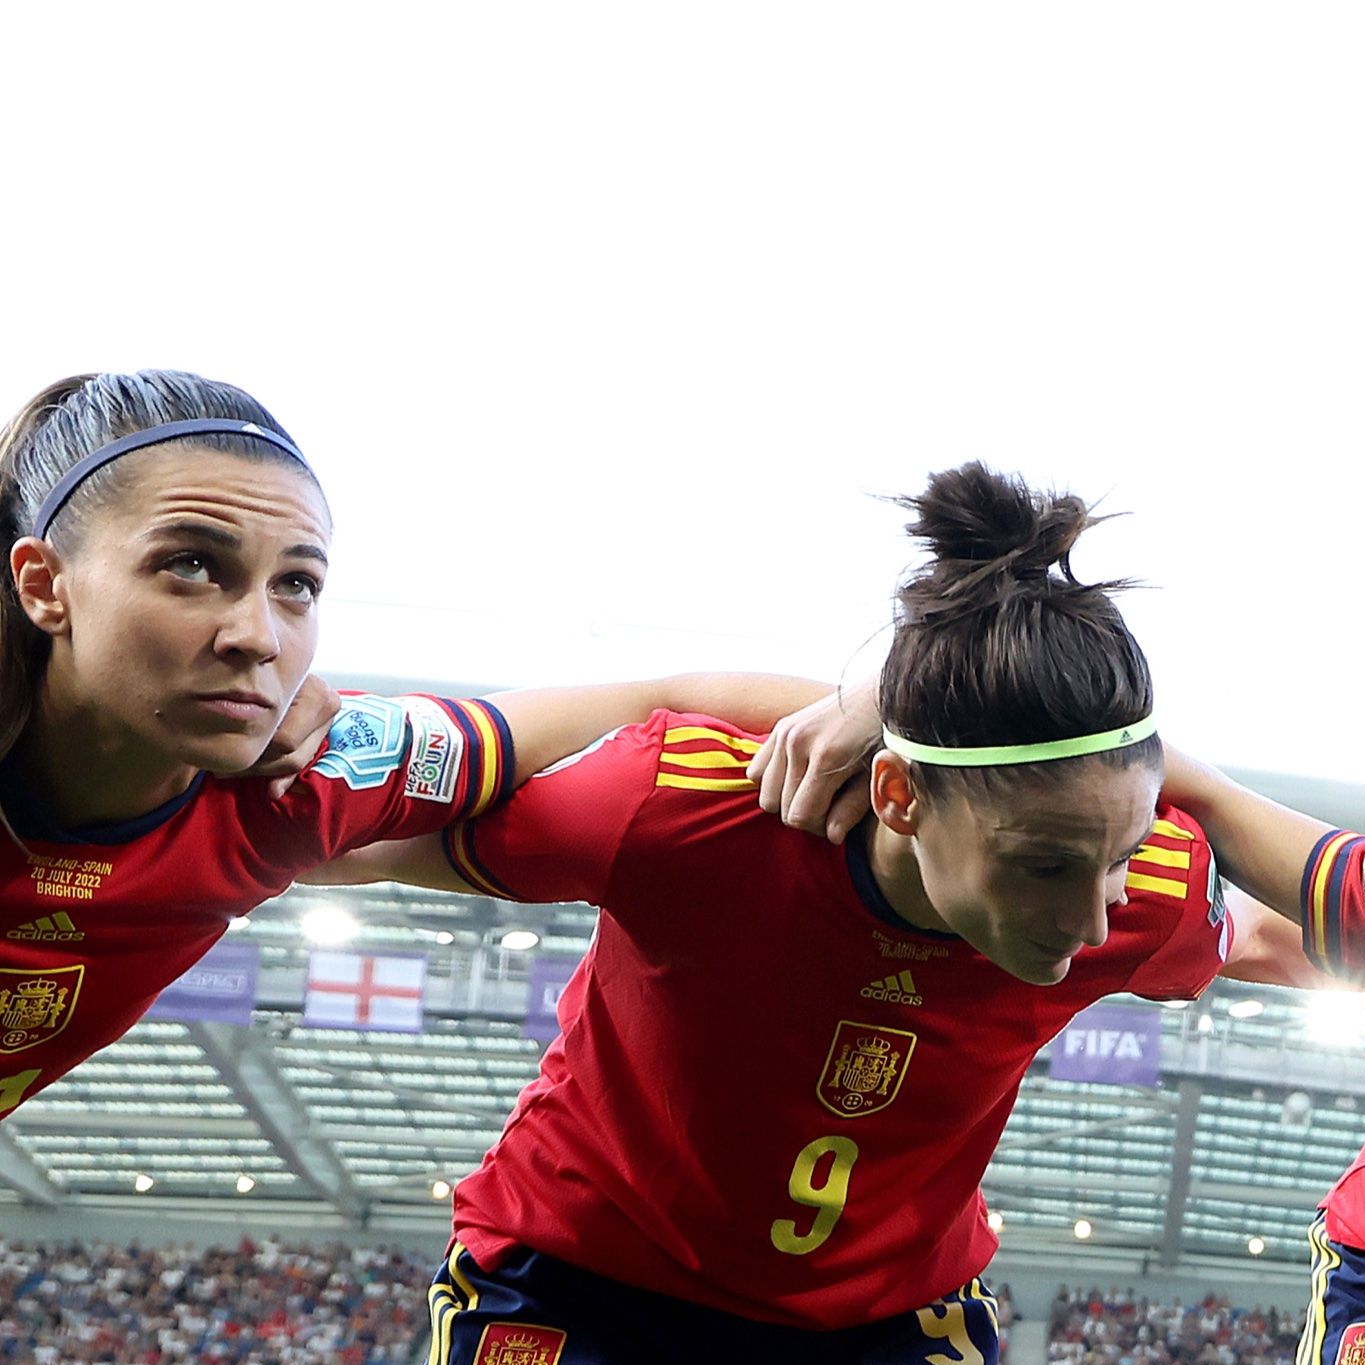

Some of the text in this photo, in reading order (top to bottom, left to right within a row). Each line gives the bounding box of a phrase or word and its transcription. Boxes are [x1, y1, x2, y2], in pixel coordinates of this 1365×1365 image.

[415, 733, 445, 795] FOUN
[31, 867, 101, 888] 20 JULY 2022
[37, 881, 93, 899] BRIGHTON
[7, 929, 85, 941] adidas
[860, 987, 923, 1007] adidas
[1065, 1029, 1142, 1058] FIFA
[771, 1135, 860, 1256] 9
